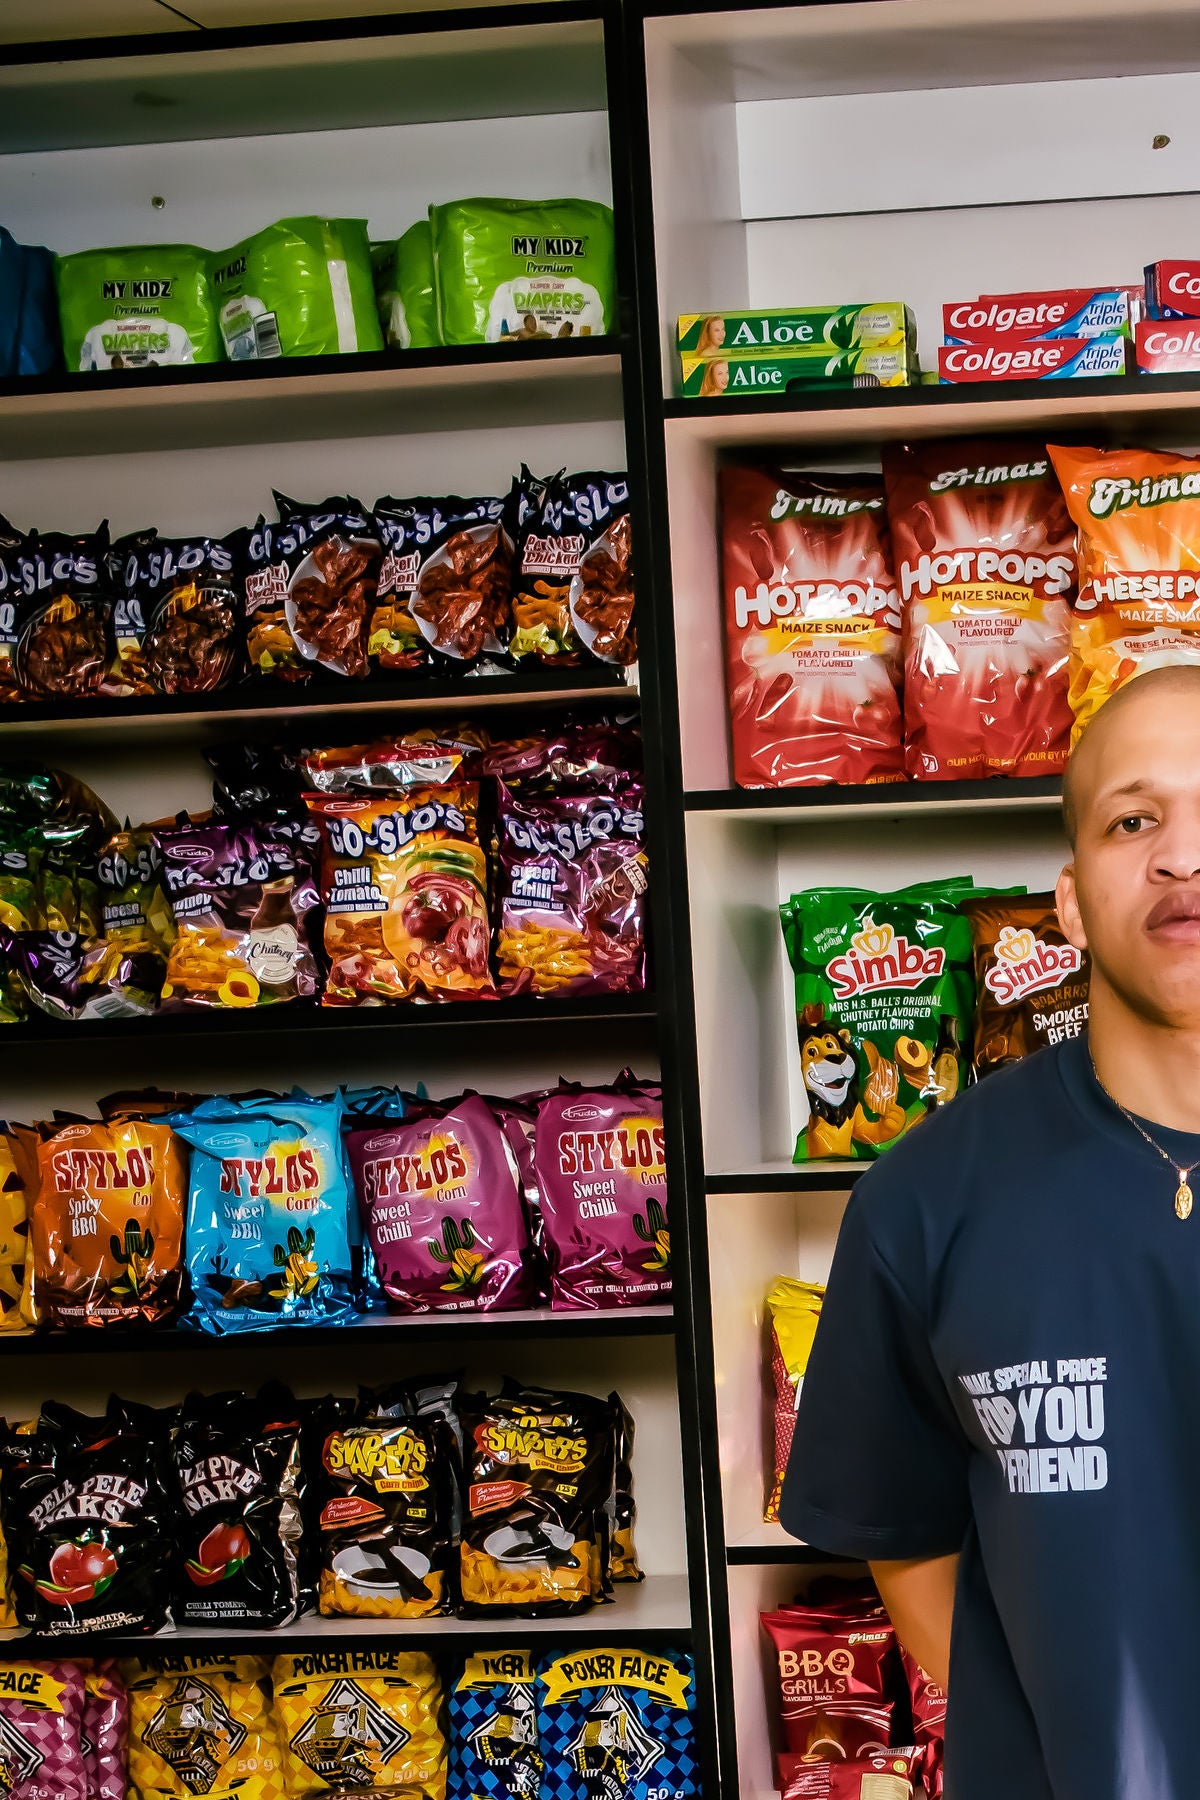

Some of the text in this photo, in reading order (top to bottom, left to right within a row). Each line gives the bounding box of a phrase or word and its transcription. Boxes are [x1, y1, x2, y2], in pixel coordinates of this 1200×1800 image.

[512, 236, 585, 256] MY KIDZ
[526, 261, 574, 274] Premium
[103, 278, 172, 299] MY KIDZ
[113, 303, 160, 316] Premium
[513, 292, 585, 309] DIAPERS
[1088, 301, 1126, 317] Triple
[949, 302, 1066, 333] Colgate
[1078, 312, 1124, 327] Action
[101, 332, 171, 350] DIAPERS
[731, 320, 814, 346] Aloe
[944, 347, 1063, 376] Colgate
[1084, 346, 1122, 361] Triple
[1076, 358, 1120, 372] Action
[732, 366, 783, 387] Aloe
[901, 551, 1075, 601] HOTPOPS
[941, 589, 1031, 603] MAIZE SNACK
[952, 617, 1023, 630] TOMATO CHILLI
[829, 995, 942, 1013] MRS H.S. BALL'S ORIGINAL
[840, 1007, 931, 1023] CHUTNEY FLAVOURED
[219, 1147, 322, 1197] STYLOS
[363, 1141, 468, 1204] STYLOS
[436, 1185, 467, 1203] Corn
[573, 1178, 616, 1199] Sweet
[68, 1195, 102, 1216] Spicy
[286, 1195, 319, 1212] Corn
[579, 1196, 618, 1219] Chilli
[71, 1217, 97, 1238] BBQ
[1056, 1357, 1108, 1384] PRICE
[1018, 1384, 1105, 1443] YOU
[1006, 1445, 1109, 1493] FRIEND
[37, 1492, 127, 1532] NAKS
[560, 1653, 671, 1687] POKER FACE
[779, 1648, 855, 1678] BBQ
[780, 1678, 846, 1695] GRILLS
[237, 1757, 274, 1773] 50 g
